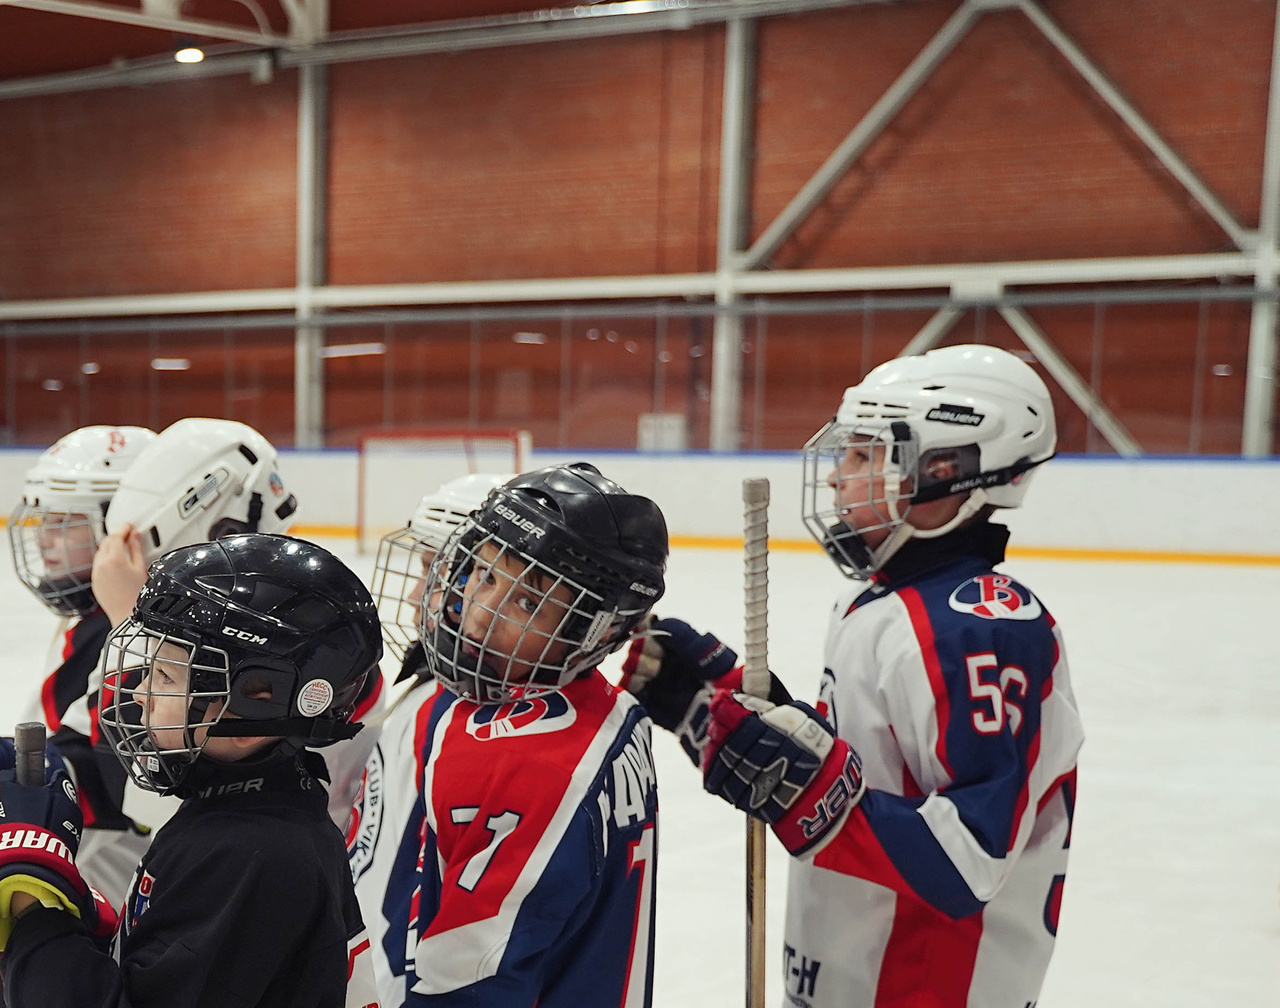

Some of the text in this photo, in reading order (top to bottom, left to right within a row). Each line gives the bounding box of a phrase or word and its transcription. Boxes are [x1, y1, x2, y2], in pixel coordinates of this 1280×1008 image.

[494, 503, 547, 541] BAUER
[221, 625, 270, 647] CCM
[796, 745, 864, 840] UER
